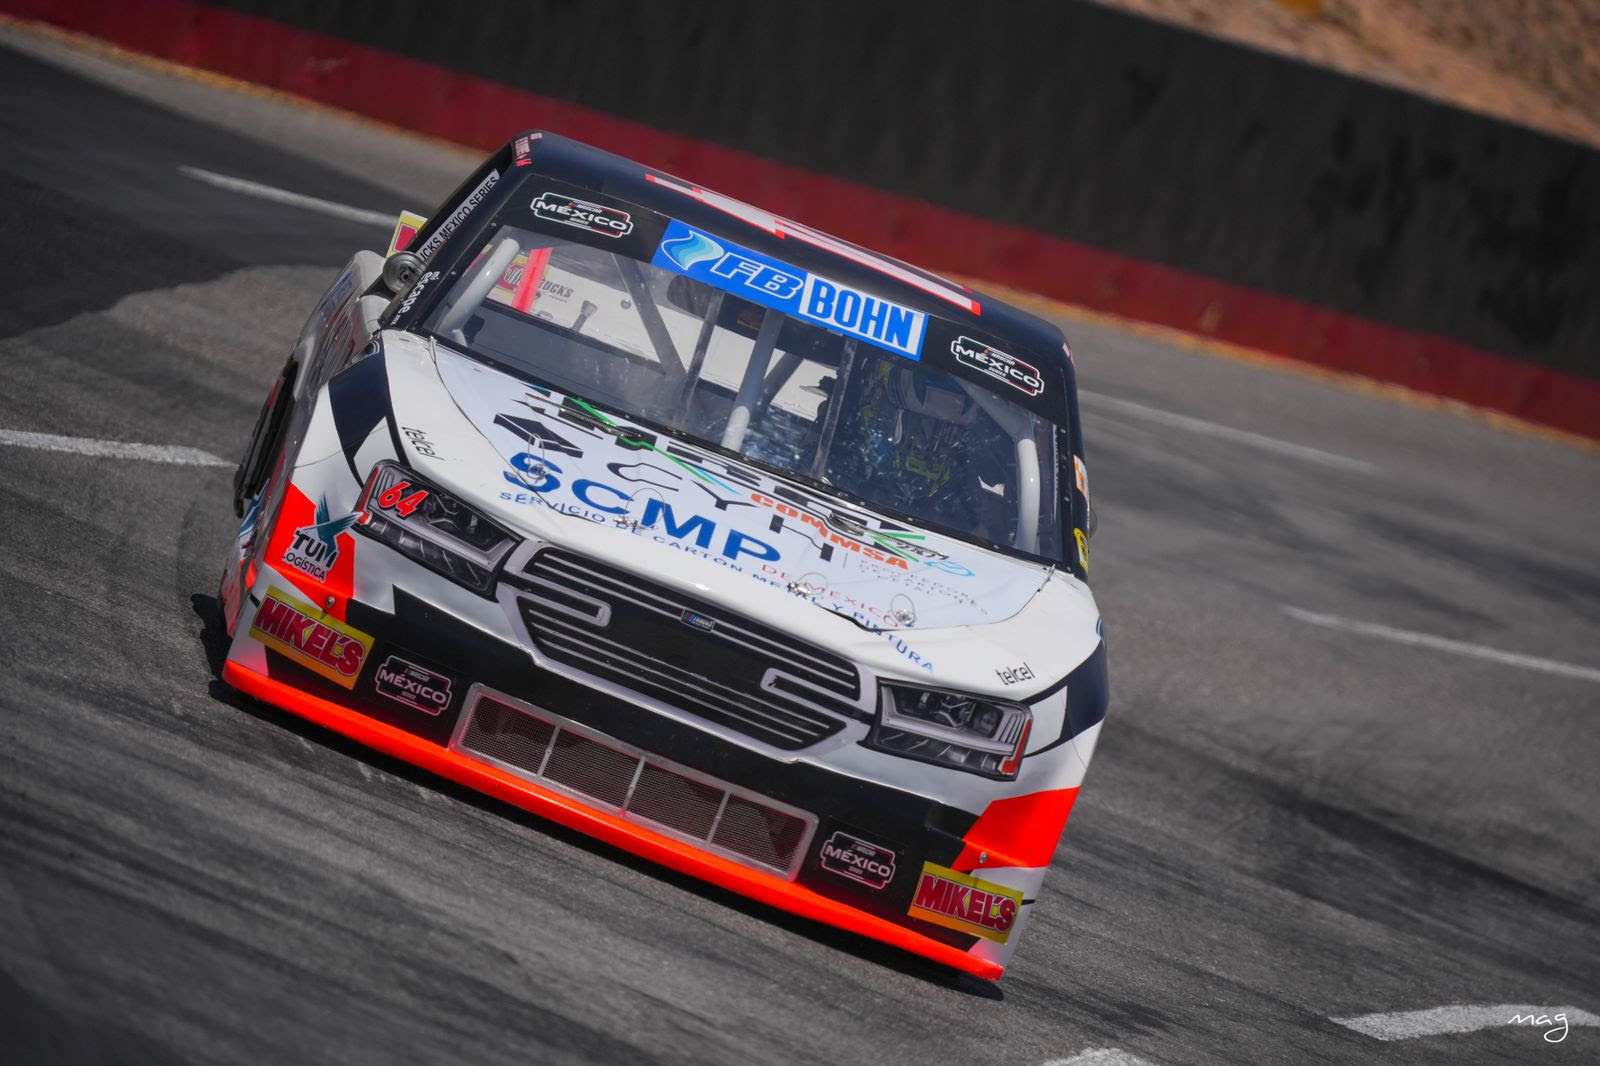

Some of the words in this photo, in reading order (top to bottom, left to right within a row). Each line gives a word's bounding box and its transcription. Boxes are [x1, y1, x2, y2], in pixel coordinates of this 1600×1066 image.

[438, 205, 473, 241] MEXICO
[469, 176, 497, 211] SERIES
[398, 271, 433, 314] escape
[710, 252, 804, 299] FB
[806, 277, 915, 349] BOHN
[401, 426, 445, 461] telcel
[378, 480, 429, 520] 64
[502, 451, 781, 562] SCMP
[283, 552, 326, 581] OGÍSTICA
[292, 529, 338, 568] TUM
[499, 490, 606, 523] SERVICIO
[832, 602, 844, 611] Y
[853, 611, 935, 672] PINTURA
[761, 564, 790, 582] DE
[254, 597, 366, 677] MIKEL'S
[379, 668, 447, 704] MÉXICO
[995, 661, 1036, 686] telcel
[825, 845, 891, 877] MÉXICO
[914, 873, 1017, 934] MIKEL'S
